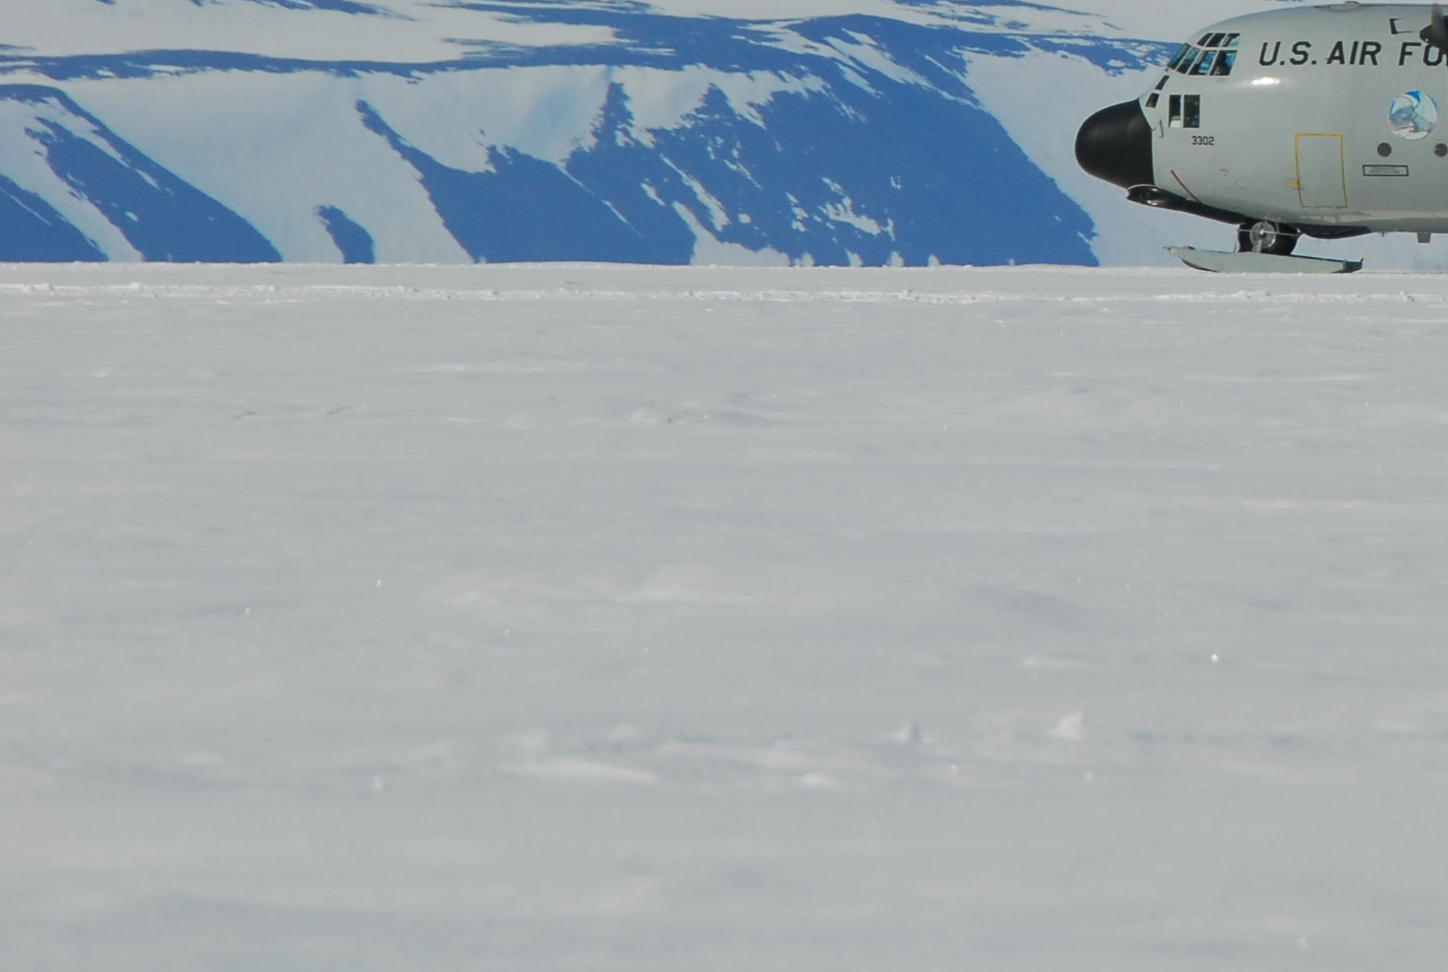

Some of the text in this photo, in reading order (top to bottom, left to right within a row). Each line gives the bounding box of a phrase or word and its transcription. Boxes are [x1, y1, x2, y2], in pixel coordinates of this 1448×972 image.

[1259, 40, 1448, 66] U.S. AIR FO
[1191, 135, 1215, 146] 3302
